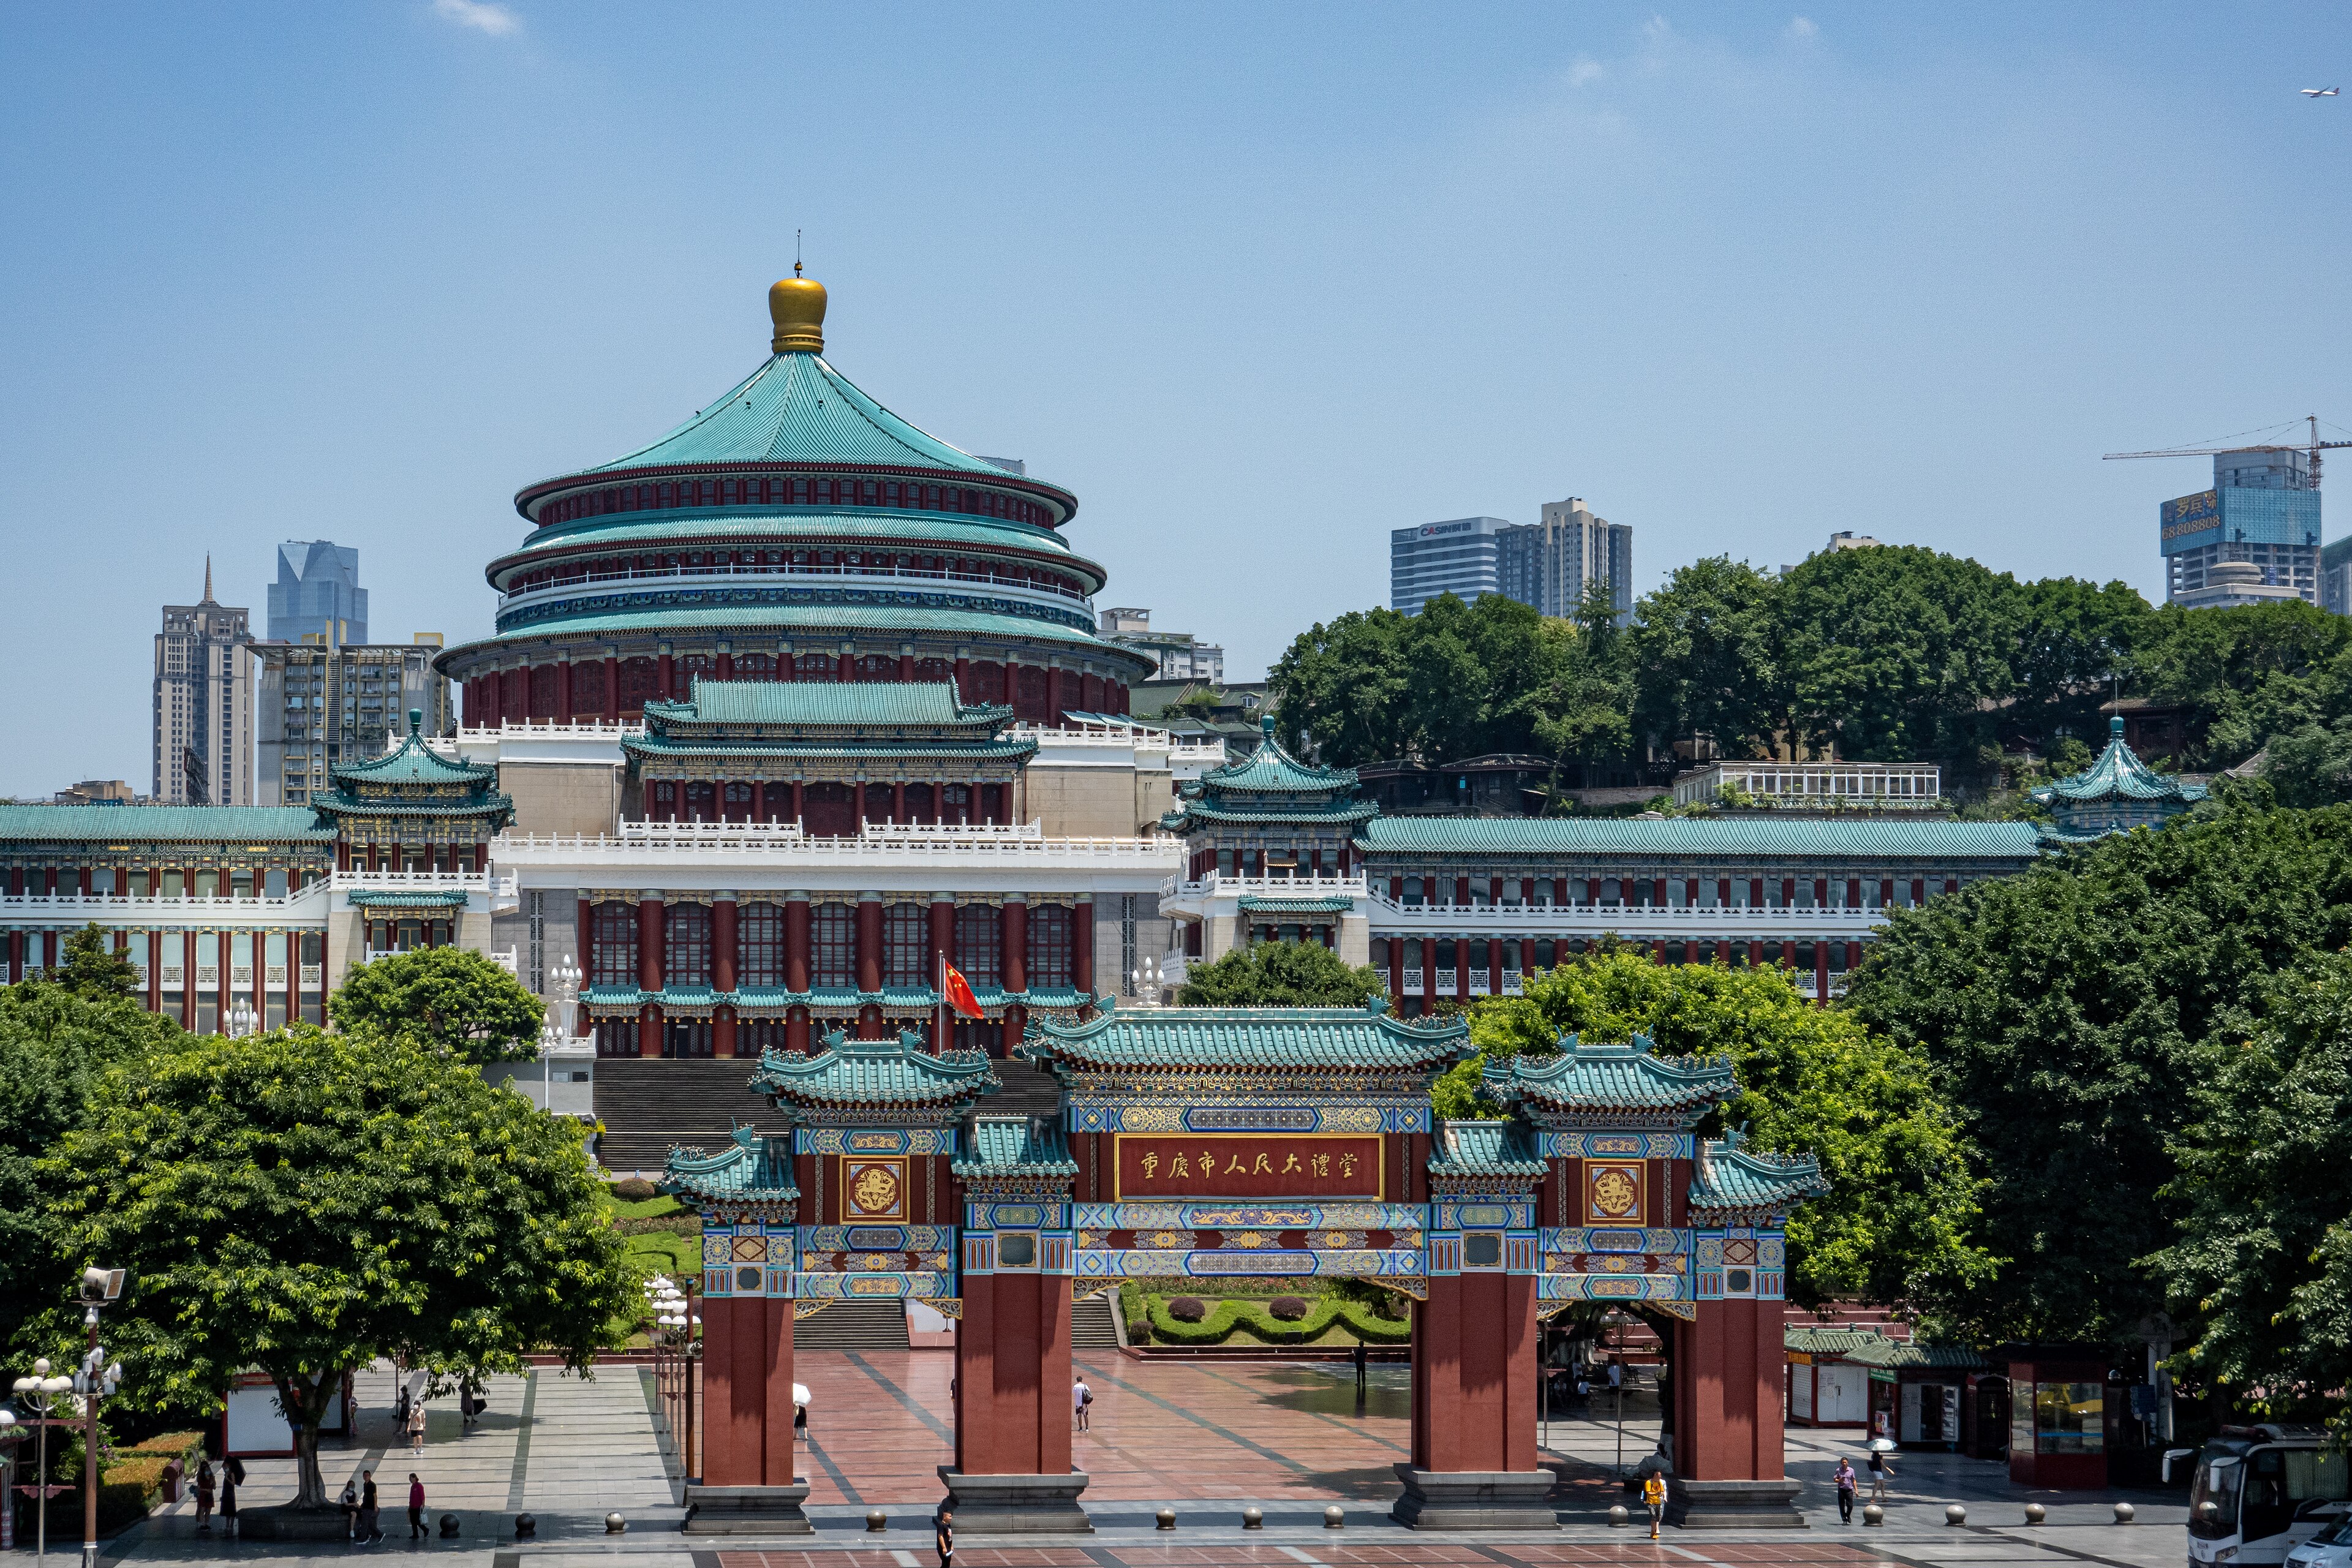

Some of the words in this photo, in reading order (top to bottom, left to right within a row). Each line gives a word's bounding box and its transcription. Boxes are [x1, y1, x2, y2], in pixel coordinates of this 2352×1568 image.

[1141, 1151, 1358, 1179] 重慶市人民大禮堂
